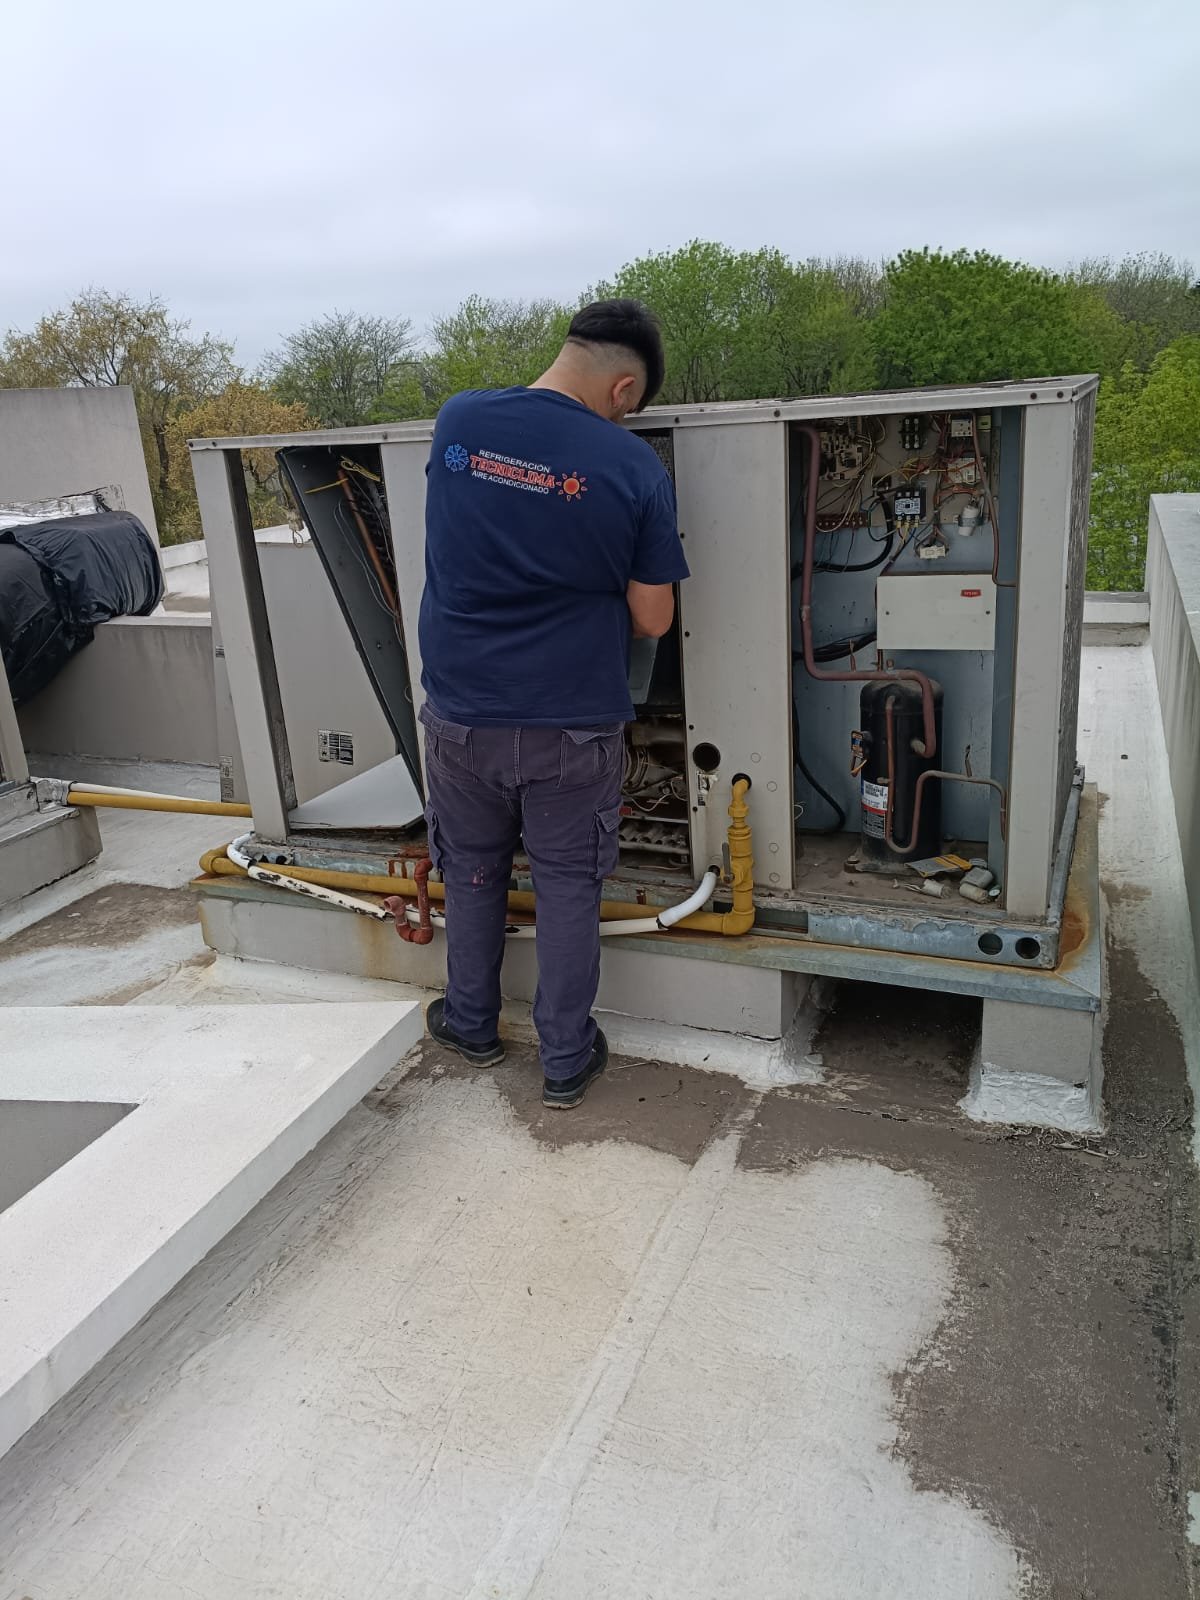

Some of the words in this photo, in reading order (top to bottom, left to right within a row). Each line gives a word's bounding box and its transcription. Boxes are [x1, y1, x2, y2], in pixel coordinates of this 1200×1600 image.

[470, 455, 555, 488] TECNICLIMA
[479, 449, 550, 473] REFRIGERACIÓN
[472, 470, 488, 480] AIRE
[488, 475, 549, 494] ACONDICIONADO
